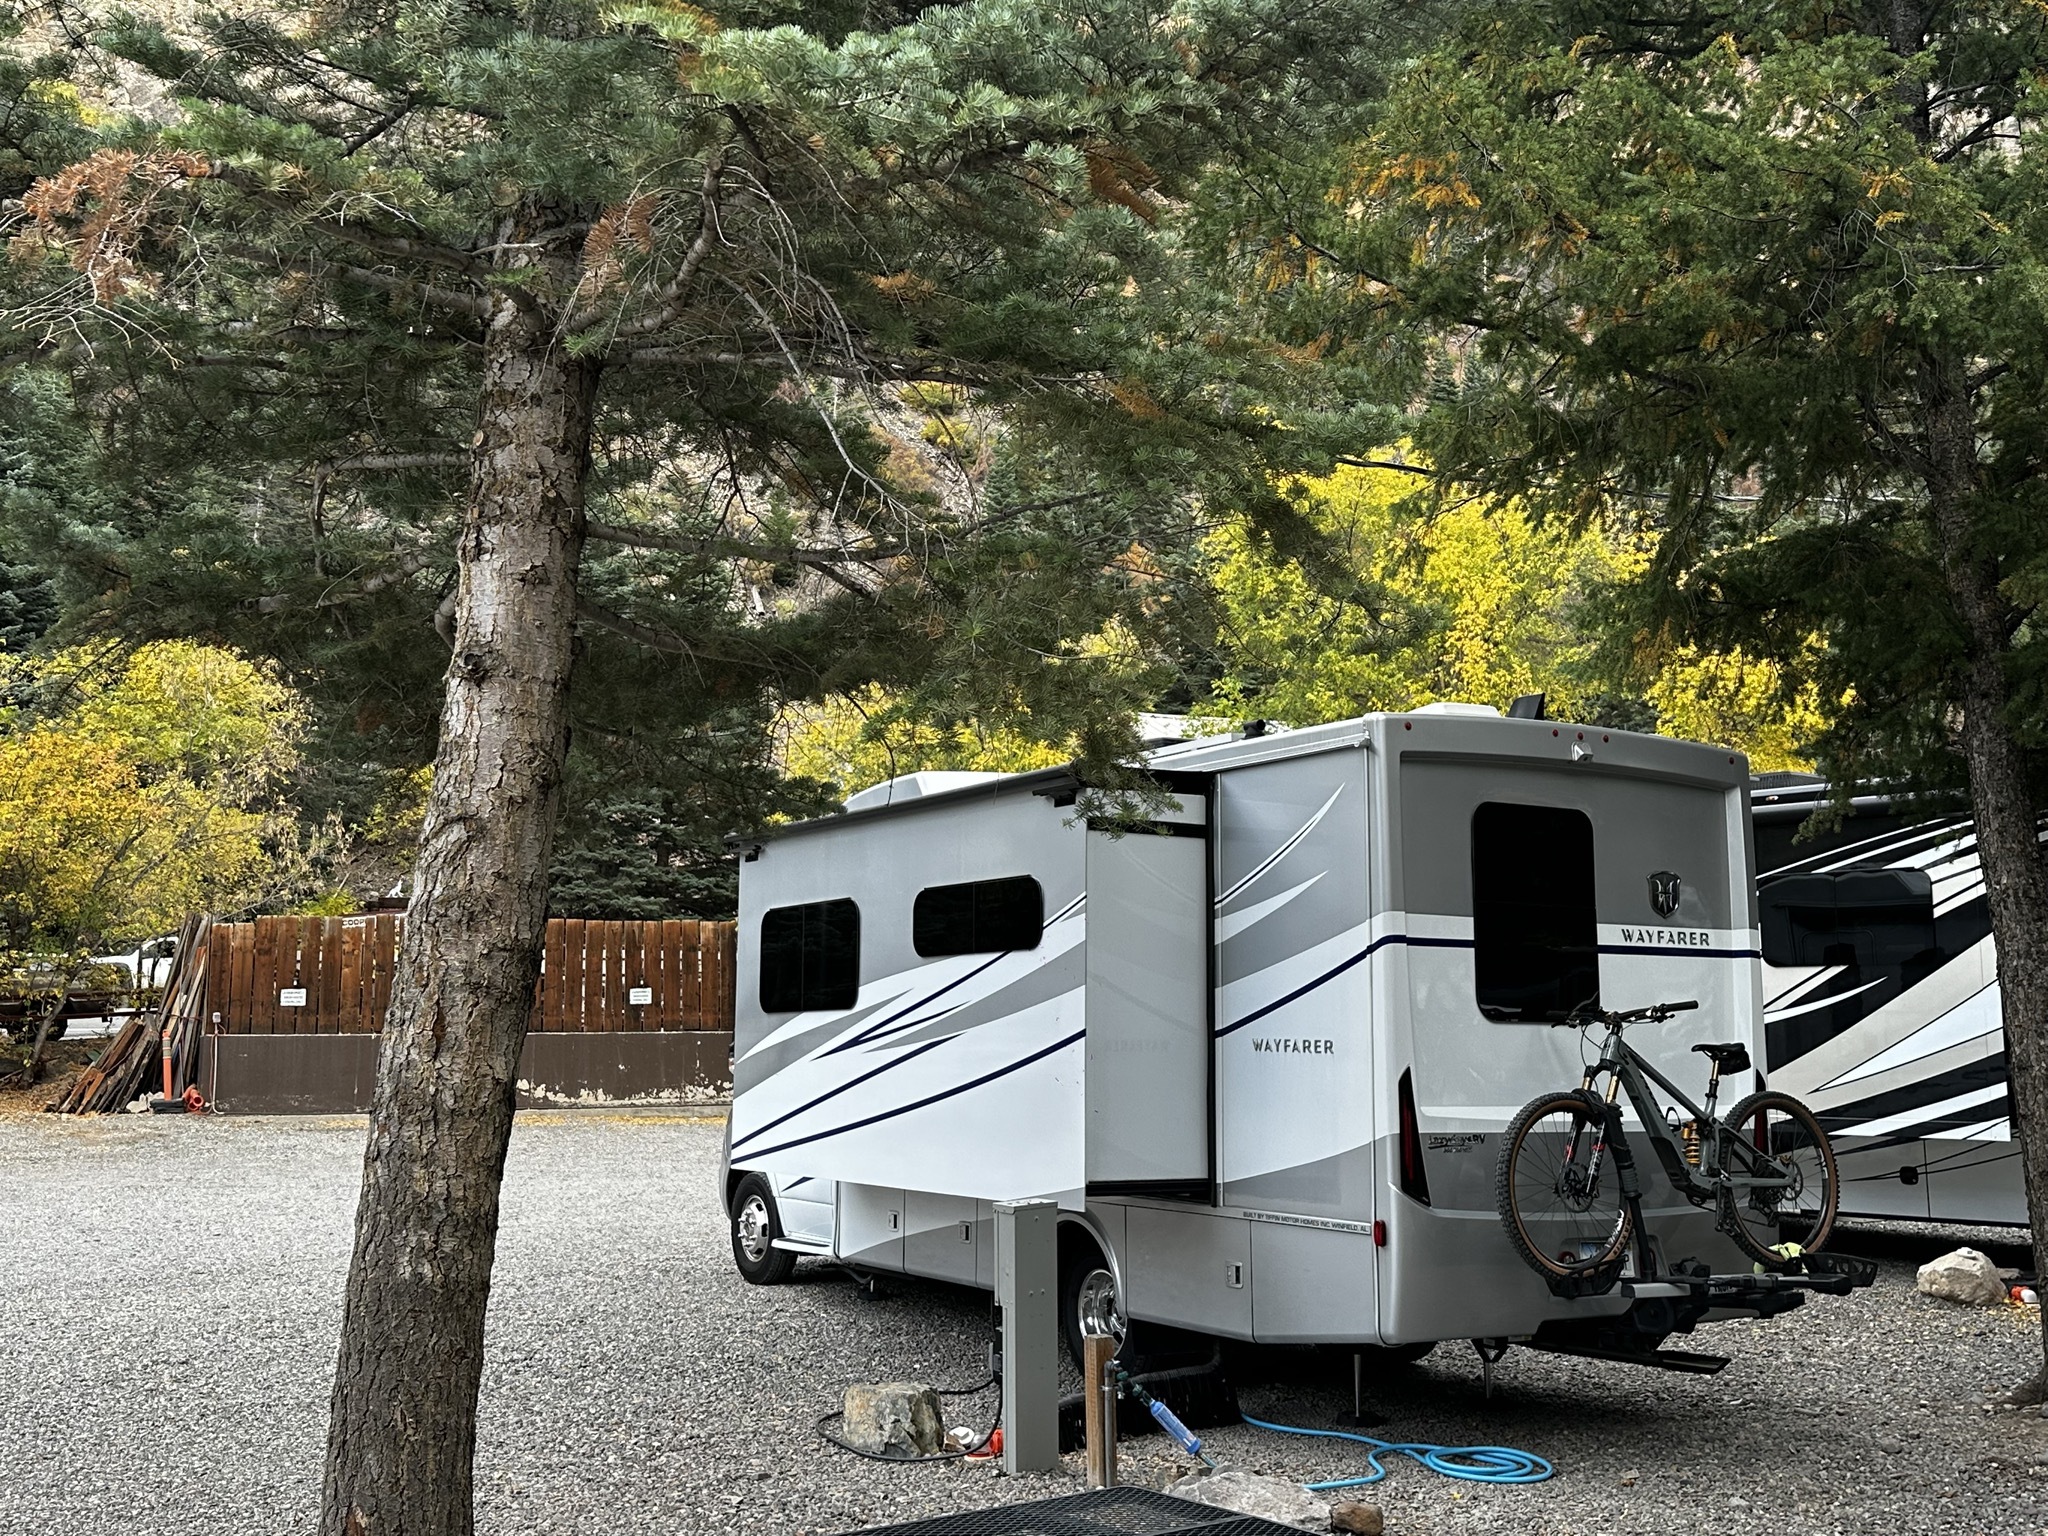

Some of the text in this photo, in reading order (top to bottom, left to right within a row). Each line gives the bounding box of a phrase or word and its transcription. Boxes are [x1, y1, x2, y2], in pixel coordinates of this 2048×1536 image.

[1621, 928, 1710, 946] WAYFARER
[1252, 1038, 1334, 1054] WAYFARER
[1243, 1211, 1257, 1219] BUILT
[1265, 1213, 1281, 1222] TIFFIN
[1281, 1216, 1300, 1224] MOTOR
[1300, 1218, 1320, 1227] HOMES
